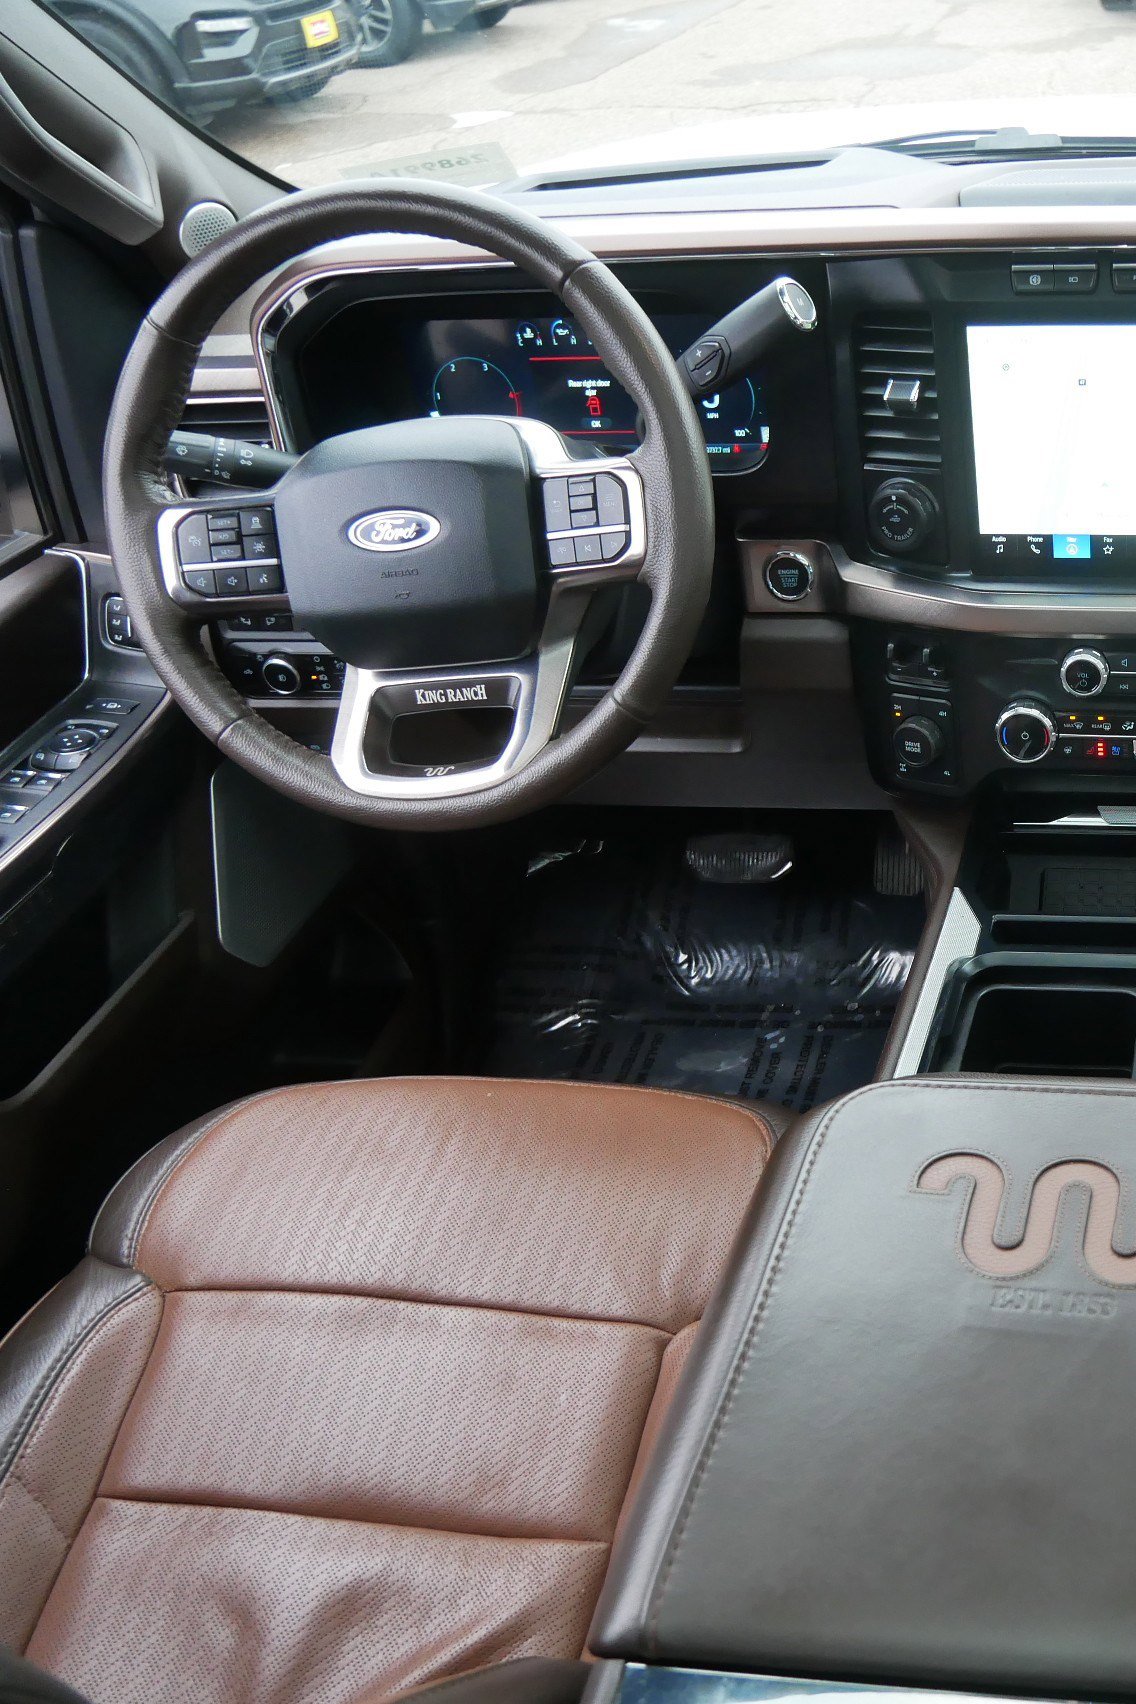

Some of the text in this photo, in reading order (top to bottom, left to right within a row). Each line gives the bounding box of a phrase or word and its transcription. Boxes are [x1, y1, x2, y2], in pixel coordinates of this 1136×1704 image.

[450, 364, 456, 372] 2
[734, 429, 746, 437] 100
[371, 518, 417, 542] Ford
[882, 526, 914, 541] PRO TRAILER
[414, 684, 488, 705] KING RANCH
